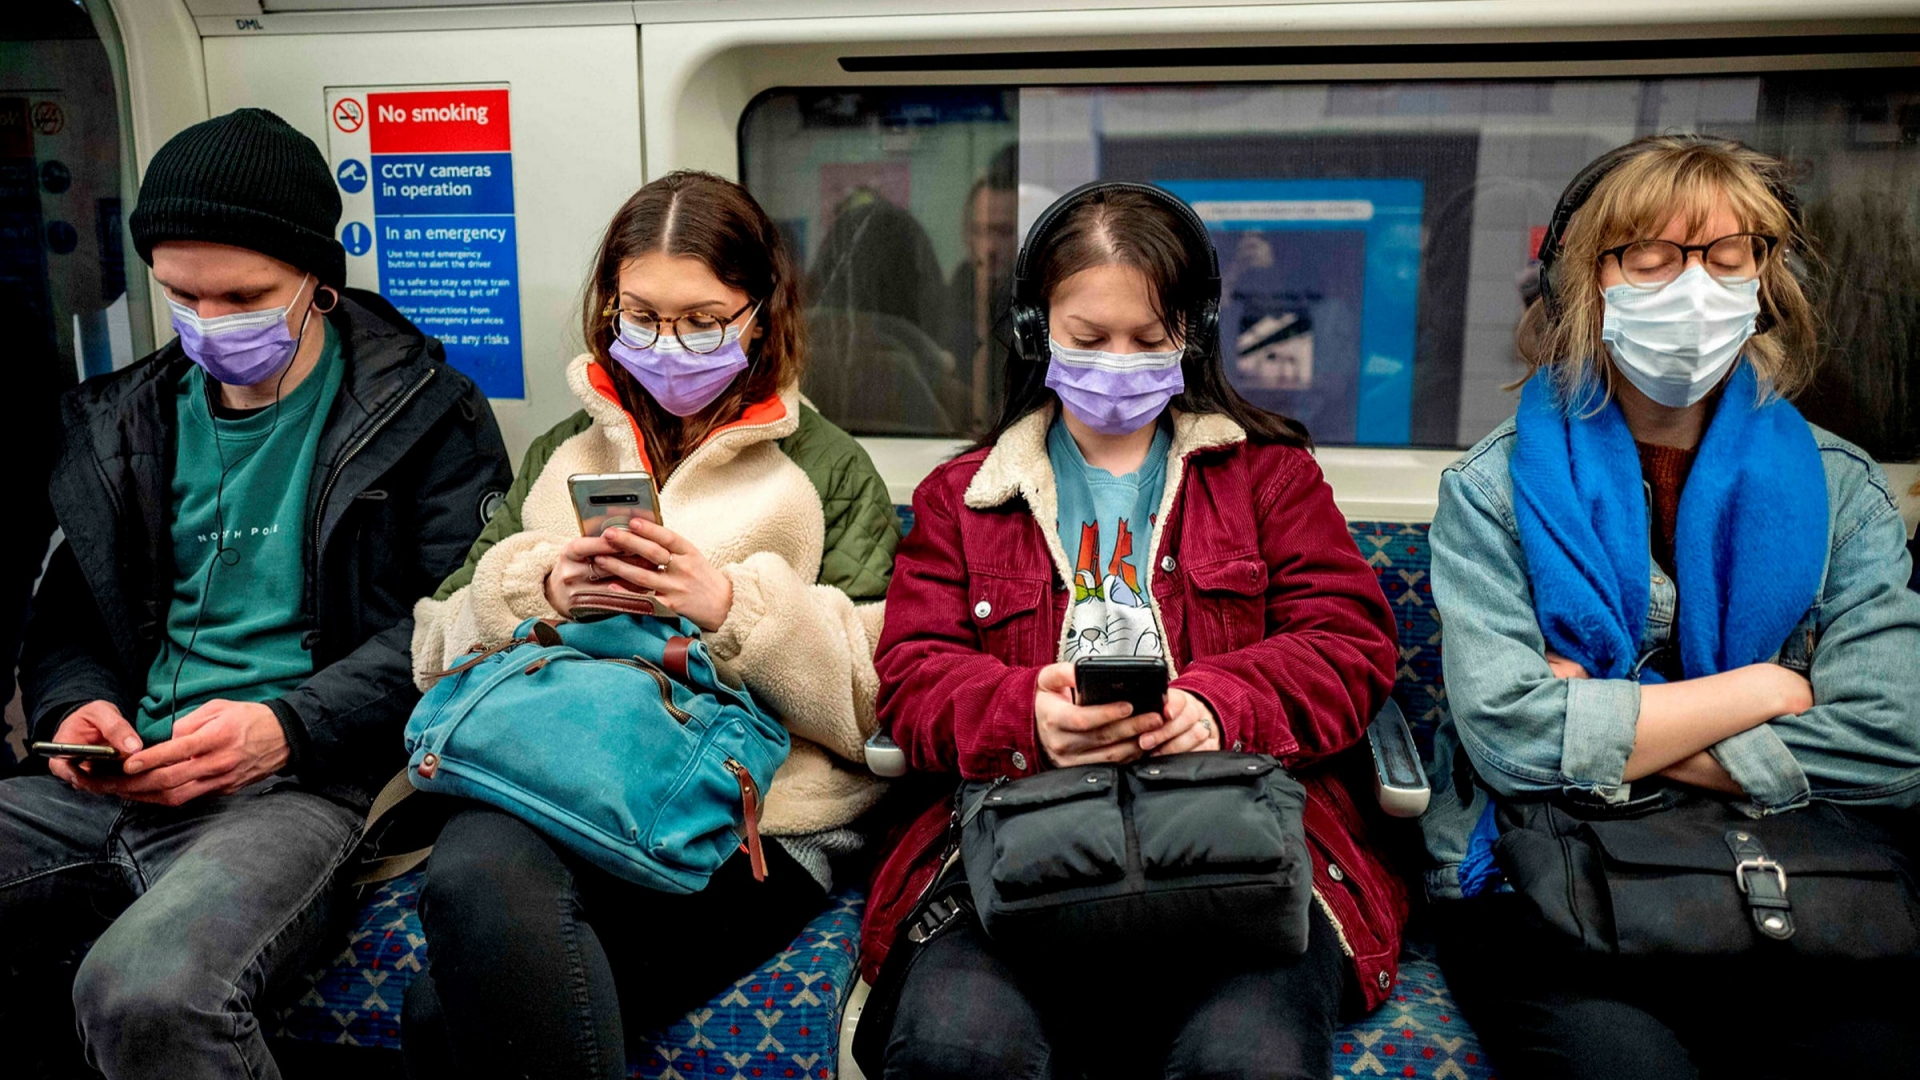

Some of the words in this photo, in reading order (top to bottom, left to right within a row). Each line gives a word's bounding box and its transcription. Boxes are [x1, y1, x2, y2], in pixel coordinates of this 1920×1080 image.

[378, 104, 406, 123] No
[412, 103, 488, 124] smoking
[381, 164, 425, 178] CCTV
[430, 165, 492, 177] cameras
[383, 183, 396, 196] in
[401, 182, 472, 199] operation
[386, 227, 399, 239] In
[404, 229, 421, 240] an
[425, 228, 506, 243] emergency
[387, 250, 403, 258] Use
[405, 250, 419, 258] the
[421, 250, 435, 258] red
[437, 251, 482, 260] emergency
[387, 260, 416, 268] button
[418, 260, 427, 268] to
[429, 260, 448, 268] alert
[451, 260, 465, 268] the
[467, 260, 492, 268] driver
[388, 278, 396, 286] It
[398, 278, 405, 286] is
[407, 277, 427, 286] safer
[429, 278, 439, 286] to
[441, 278, 458, 288] stay
[473, 278, 488, 286] the
[490, 278, 510, 286] train
[389, 288, 408, 297] than
[410, 288, 456, 298] attempting
[457, 288, 467, 297] to
[469, 288, 483, 298] get
[485, 287, 499, 297] off
[419, 305, 467, 315] instructions
[469, 305, 490, 314] from
[424, 316, 468, 326] emergency
[471, 316, 504, 325] services
[461, 334, 480, 346] any
[483, 333, 510, 345] risks
[198, 530, 242, 542] NOTH
